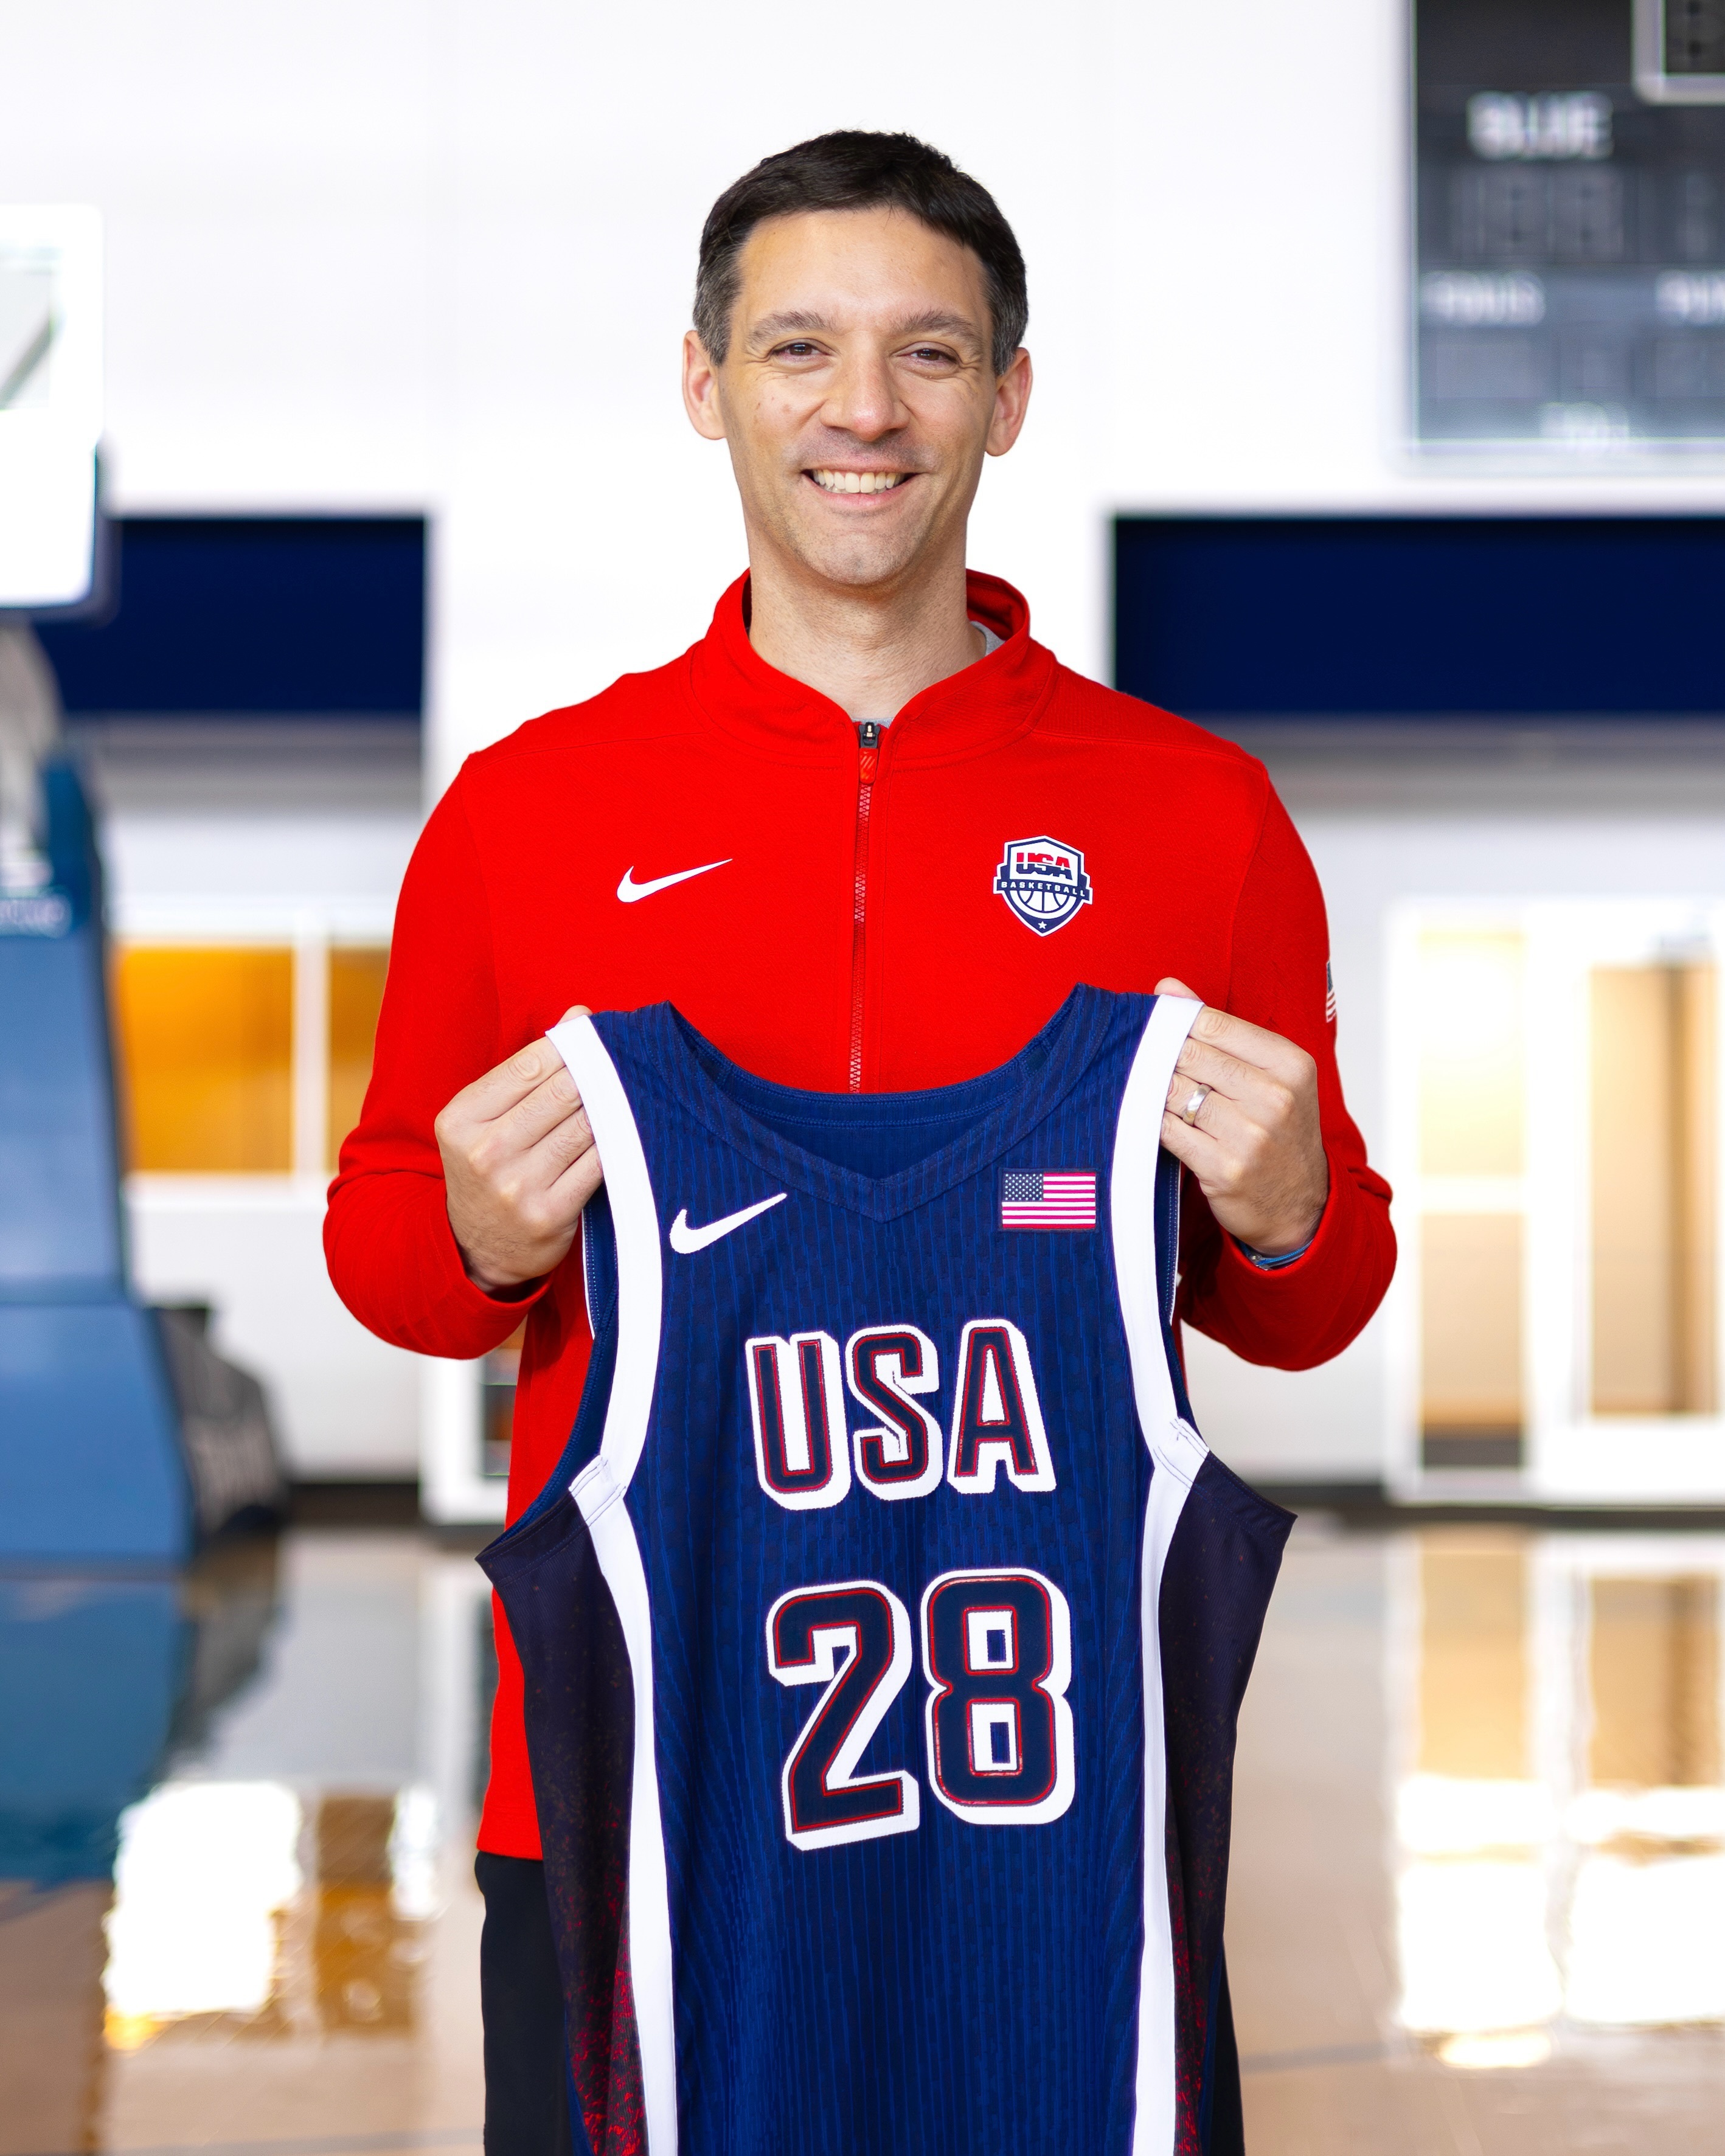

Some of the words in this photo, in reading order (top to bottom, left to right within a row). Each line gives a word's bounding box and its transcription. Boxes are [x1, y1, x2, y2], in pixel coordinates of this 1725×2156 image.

[1001, 881, 1085, 897] BASKETBALL
[1016, 853, 1073, 881] USA
[745, 1319, 1057, 1511] USA
[765, 1567, 1075, 1851] 28
